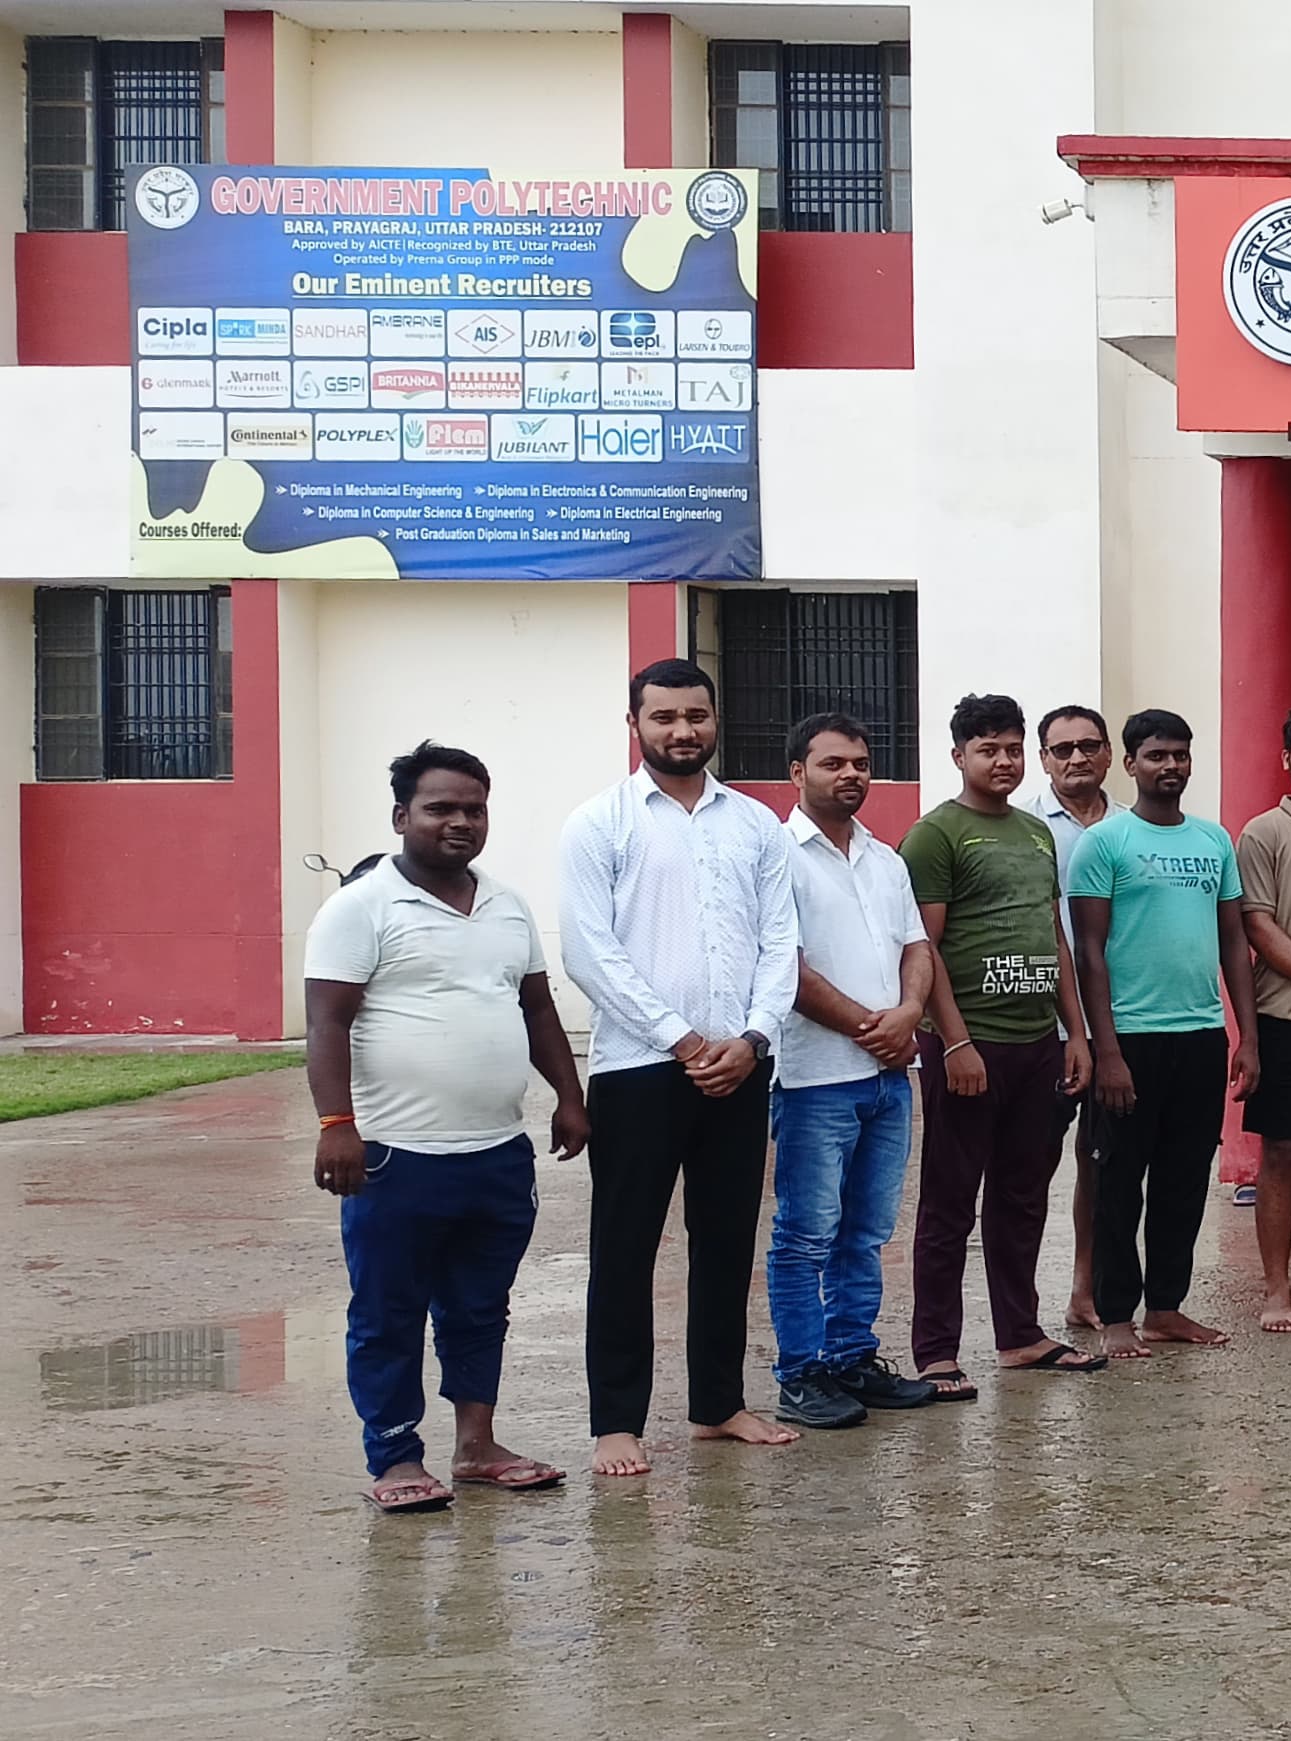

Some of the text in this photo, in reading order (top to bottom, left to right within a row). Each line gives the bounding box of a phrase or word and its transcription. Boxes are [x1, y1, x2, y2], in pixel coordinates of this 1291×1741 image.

[211, 176, 443, 216] GOVERNMENT
[450, 178, 673, 217] POLYTECHNIC
[283, 220, 329, 236] BARA,
[332, 220, 422, 236] PRAYAGRAJ,
[425, 222, 470, 236] UTTAR
[549, 222, 604, 236] 212107
[291, 239, 348, 252] Approved
[350, 239, 366, 252] by
[474, 240, 490, 252] by
[492, 240, 517, 252] BTE,
[519, 240, 549, 251] Uttar
[551, 240, 597, 252] Pradesh
[333, 253, 388, 266] Operated
[390, 253, 405, 266] by
[447, 254, 482, 267] Group
[485, 254, 496, 265] in
[498, 254, 520, 265] PPP
[522, 254, 555, 265] mode
[292, 272, 592, 297] Our Eminent Recruiters
[143, 317, 208, 339] Cipla
[372, 315, 443, 328] AMBRANE
[294, 325, 367, 339] SANDHAR
[474, 326, 498, 342] AIS
[524, 330, 570, 348] JBM
[633, 334, 660, 353] epl
[324, 376, 365, 392] GSPI
[377, 375, 438, 388] BRITANNIA
[527, 387, 598, 406] Flipkart
[613, 390, 663, 398] METALMAN
[679, 380, 744, 408] TAJ
[230, 428, 297, 442] Continental
[317, 428, 398, 442] POLYPLEX
[581, 419, 661, 456] Haier
[671, 424, 746, 454] HYATT
[497, 442, 569, 459] JUBILANT
[290, 484, 331, 498] Diploma
[345, 484, 400, 496] Mechanical
[402, 484, 463, 499] Engineering
[487, 485, 528, 499] Diploma
[542, 485, 597, 497] Electronics
[599, 485, 607, 497] &
[609, 485, 686, 498] Communication
[688, 486, 748, 501] Engineering
[318, 506, 359, 520] Diploma
[373, 506, 421, 520] Computer
[423, 507, 463, 519] Science
[465, 507, 473, 519] &
[475, 507, 534, 522] Engineering
[560, 507, 600, 521] Diploma
[614, 507, 660, 519] Electrical
[662, 507, 722, 522] Engineering
[139, 522, 242, 538] Courses Offered:
[395, 528, 419, 540] Post
[421, 528, 475, 541] Graduation
[477, 528, 517, 542] Diploma
[532, 528, 559, 541] Sales
[561, 528, 579, 541] and
[582, 528, 630, 544] Marketing
[1137, 853, 1219, 876] XTREME
[982, 955, 1024, 969] THE
